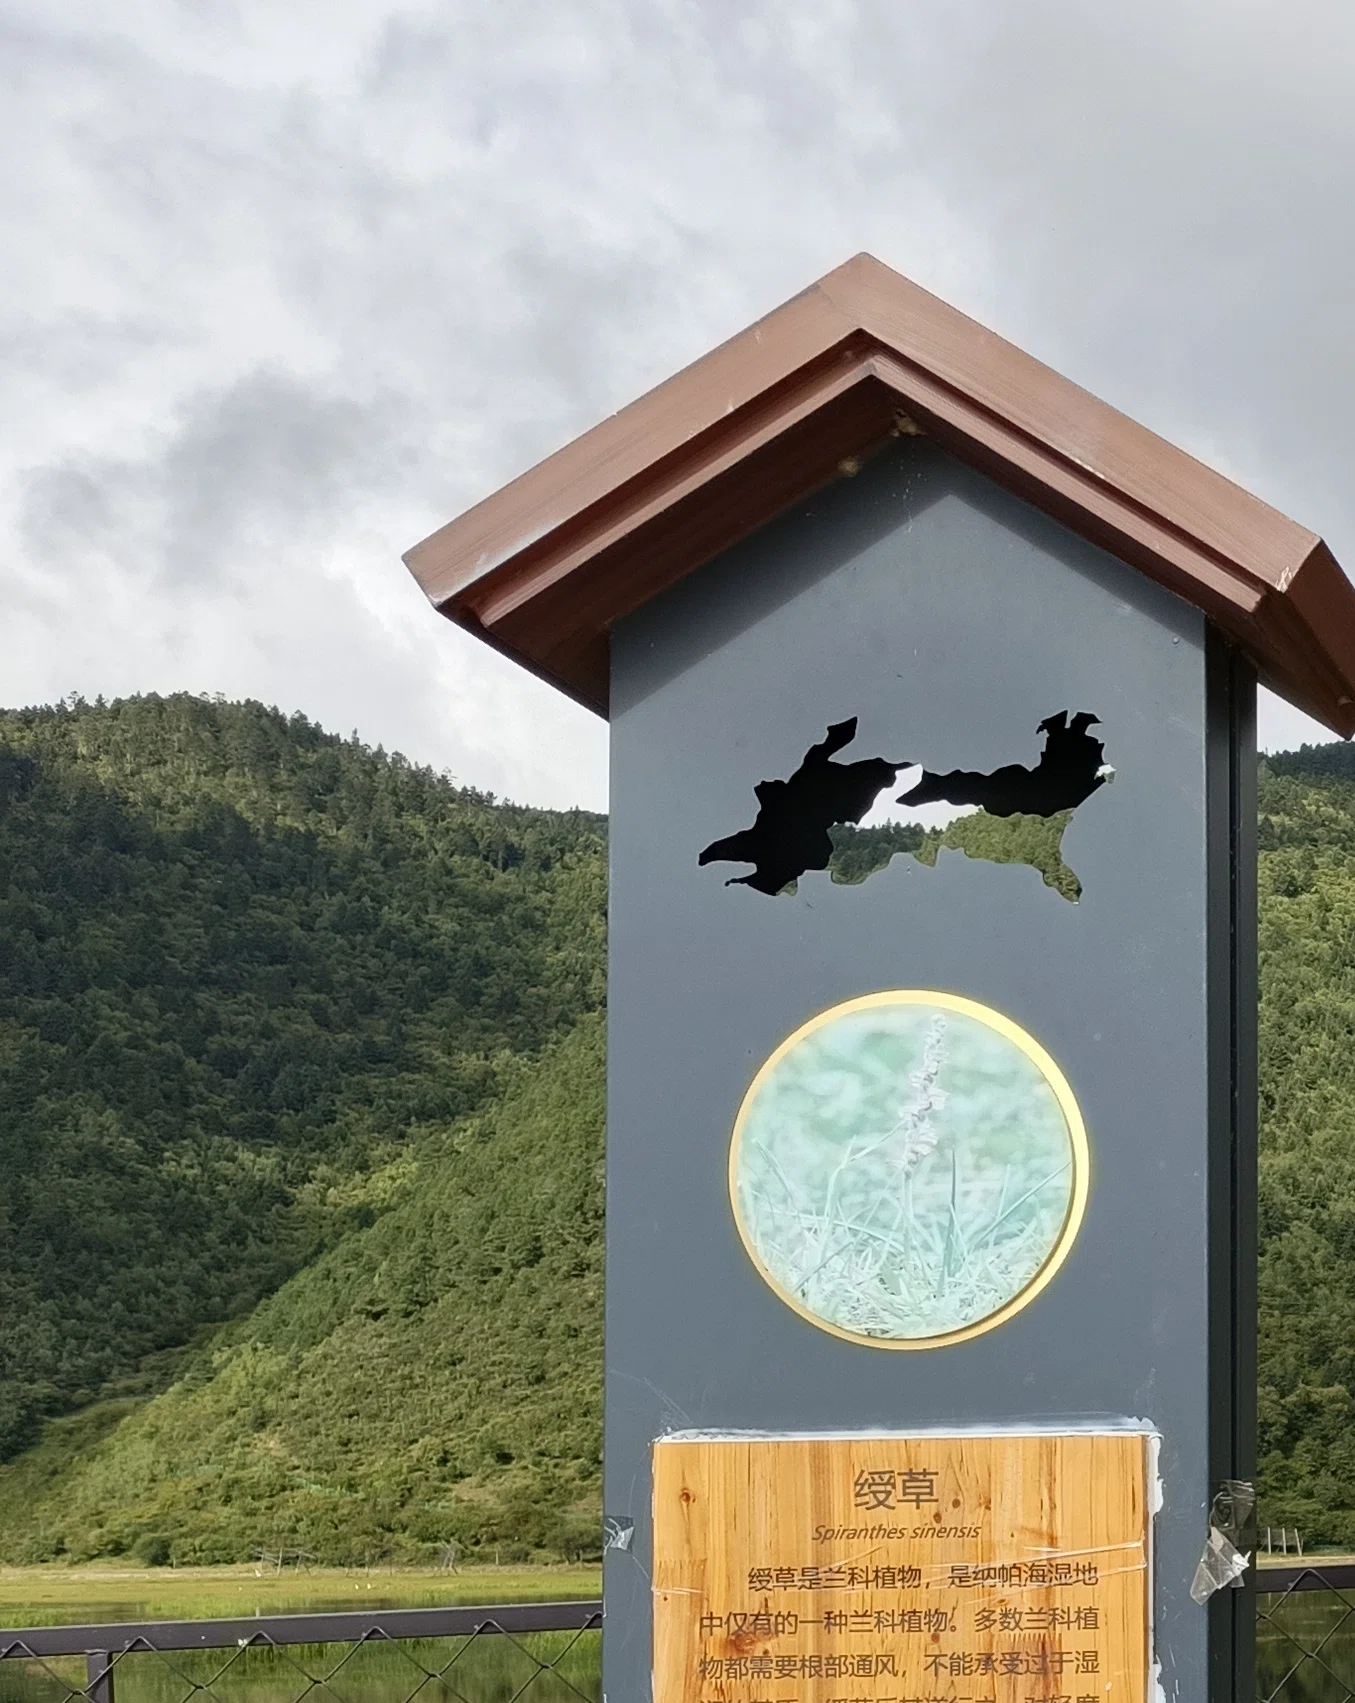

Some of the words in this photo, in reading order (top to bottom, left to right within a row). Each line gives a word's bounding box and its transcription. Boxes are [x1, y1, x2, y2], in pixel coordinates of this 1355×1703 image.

[853, 1468, 940, 1511] 绶草
[811, 1524, 907, 1543] Spiranthes
[910, 1523, 981, 1540] sinensis
